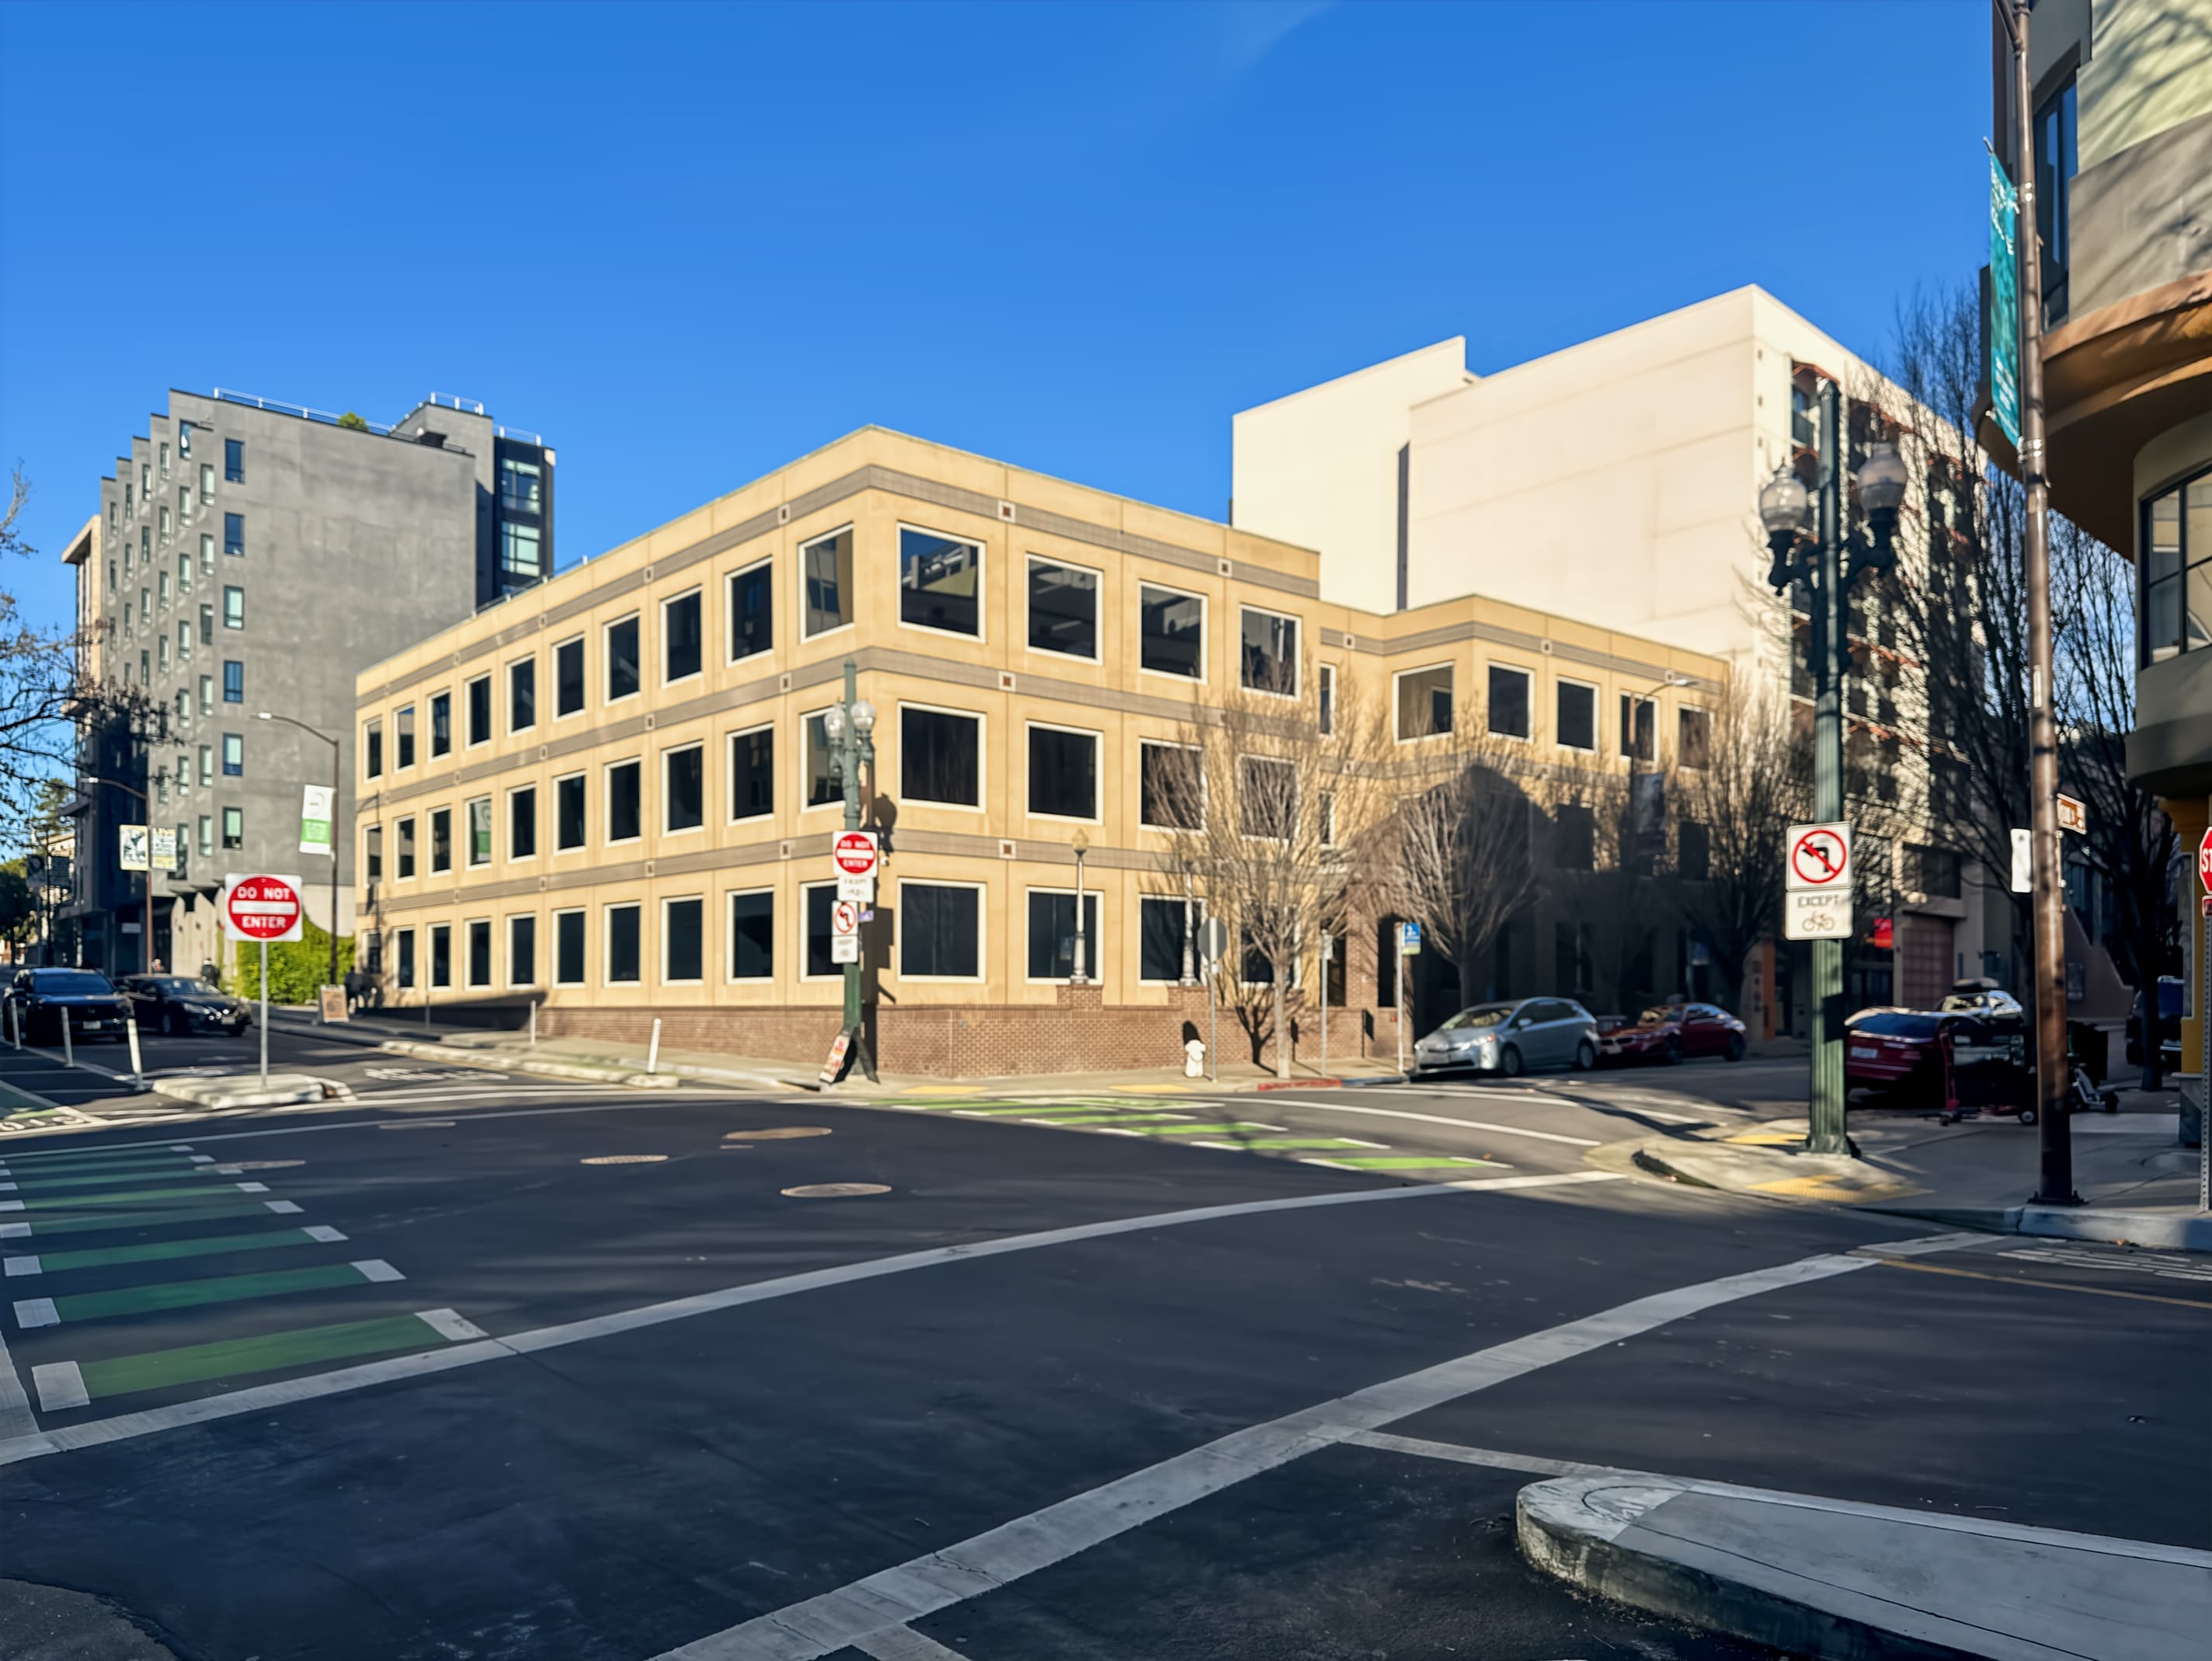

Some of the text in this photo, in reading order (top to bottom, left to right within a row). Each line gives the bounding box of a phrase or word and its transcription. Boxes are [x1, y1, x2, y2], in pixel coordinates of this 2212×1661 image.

[2202, 848, 2212, 872] ST
[237, 886, 290, 900] DO NOT
[1797, 894, 1839, 907] EXCEPT
[242, 915, 286, 928] ENTER
